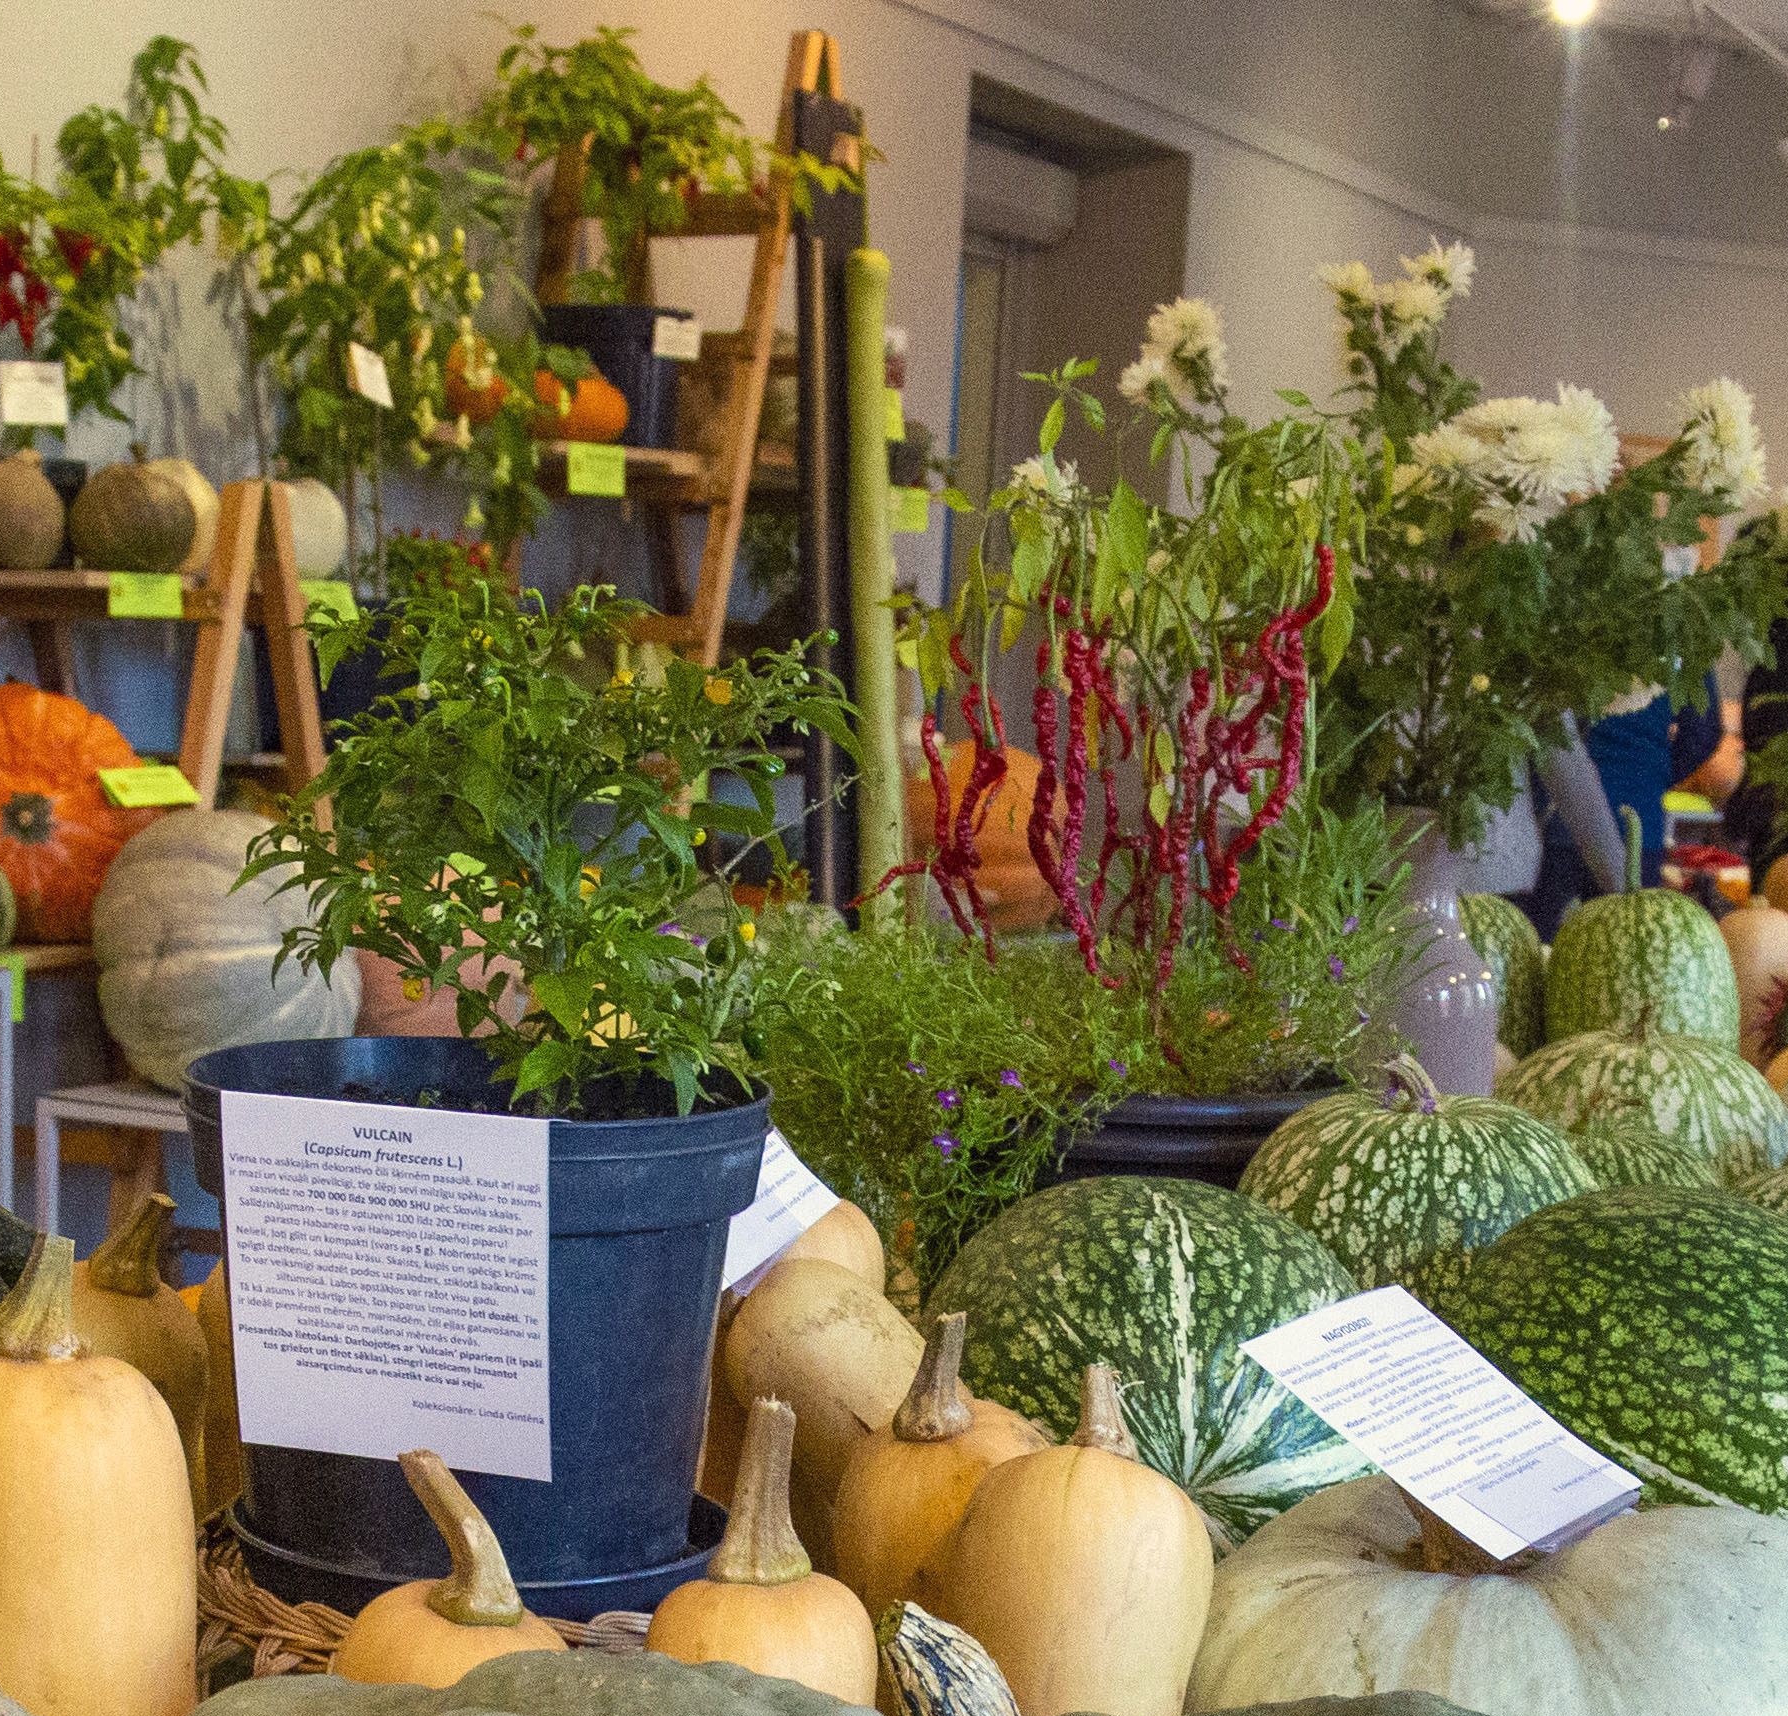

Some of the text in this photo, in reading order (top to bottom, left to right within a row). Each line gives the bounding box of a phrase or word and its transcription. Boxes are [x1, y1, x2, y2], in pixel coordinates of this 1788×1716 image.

[352, 1126, 412, 1143] VULCAIN
[303, 1140, 463, 1171] (Capsicum frutescens L.)
